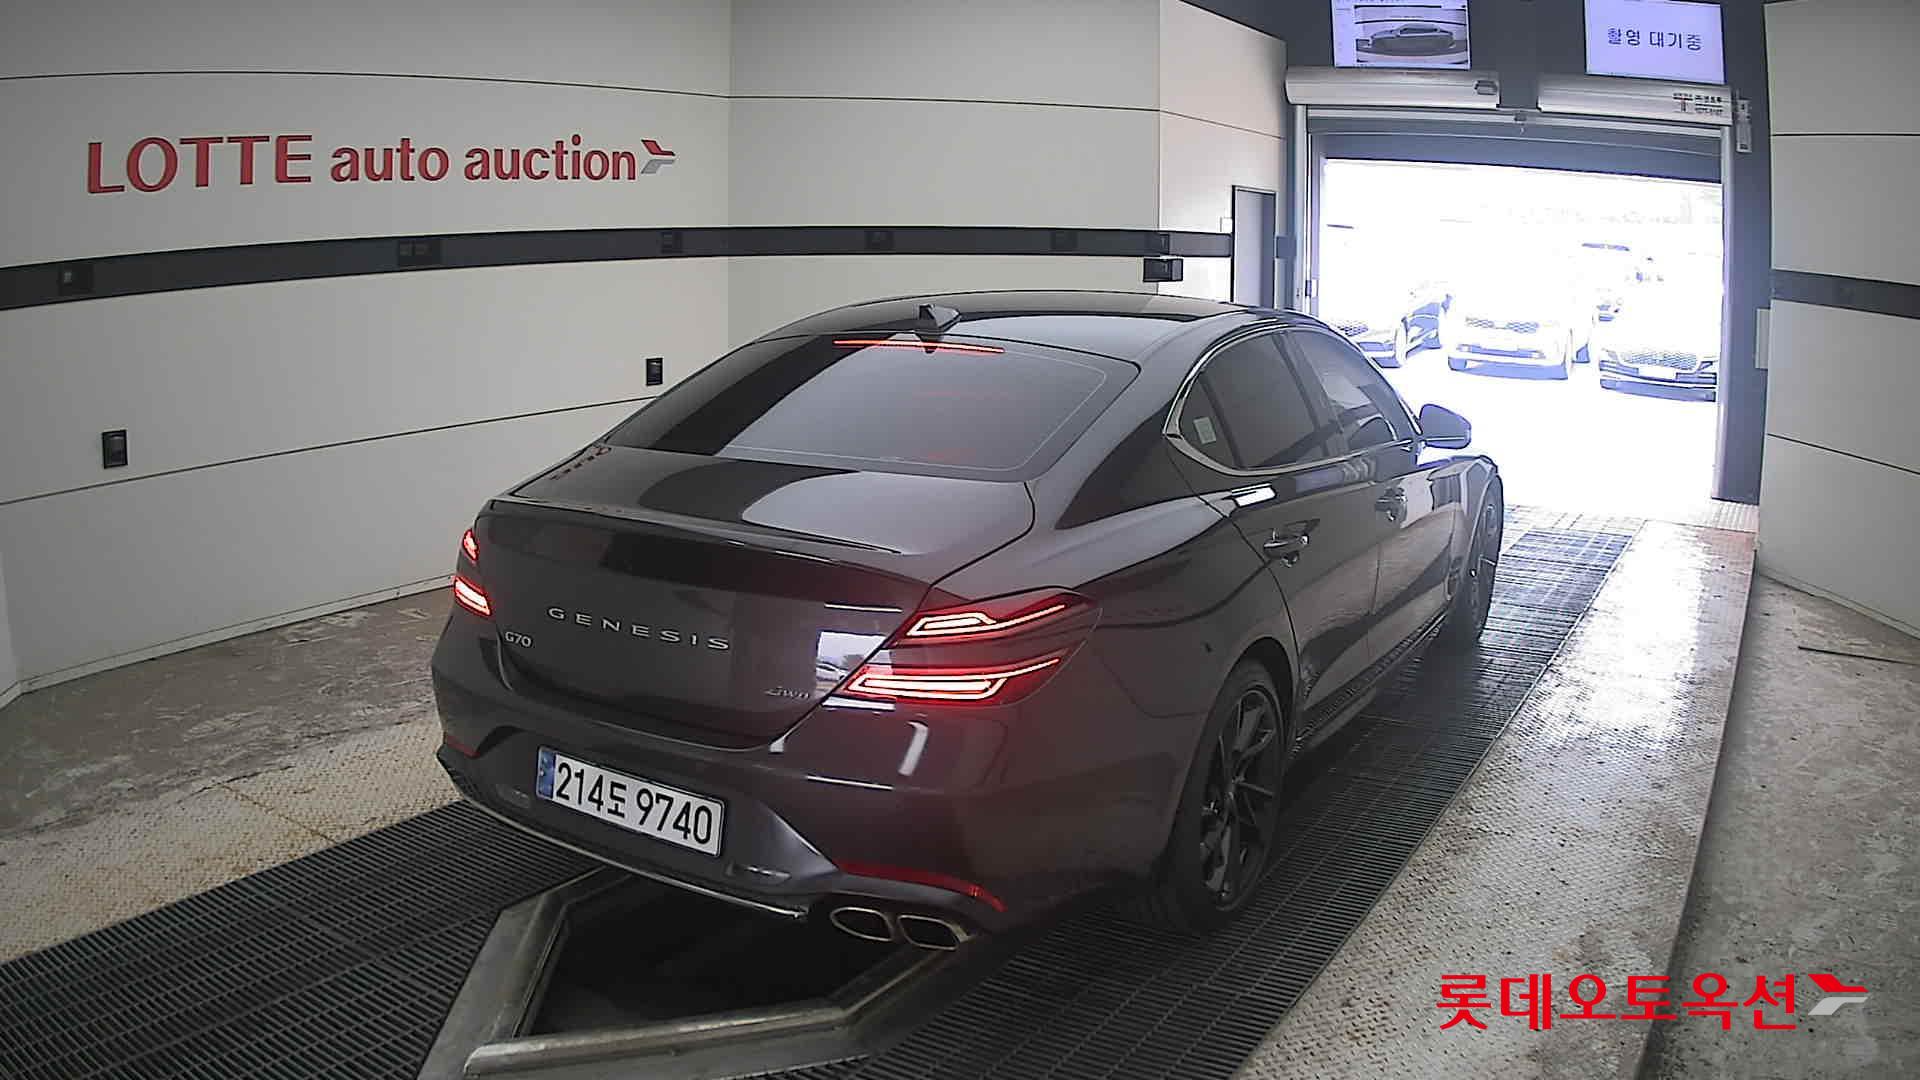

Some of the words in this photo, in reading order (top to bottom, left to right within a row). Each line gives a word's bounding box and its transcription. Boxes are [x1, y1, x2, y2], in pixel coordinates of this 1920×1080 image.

[87, 135, 312, 193] LOTTE
[331, 138, 450, 181] auto
[464, 134, 637, 181] auction
[504, 630, 533, 648] G70
[547, 606, 731, 651] GENESIS
[636, 787, 713, 845] 9740
